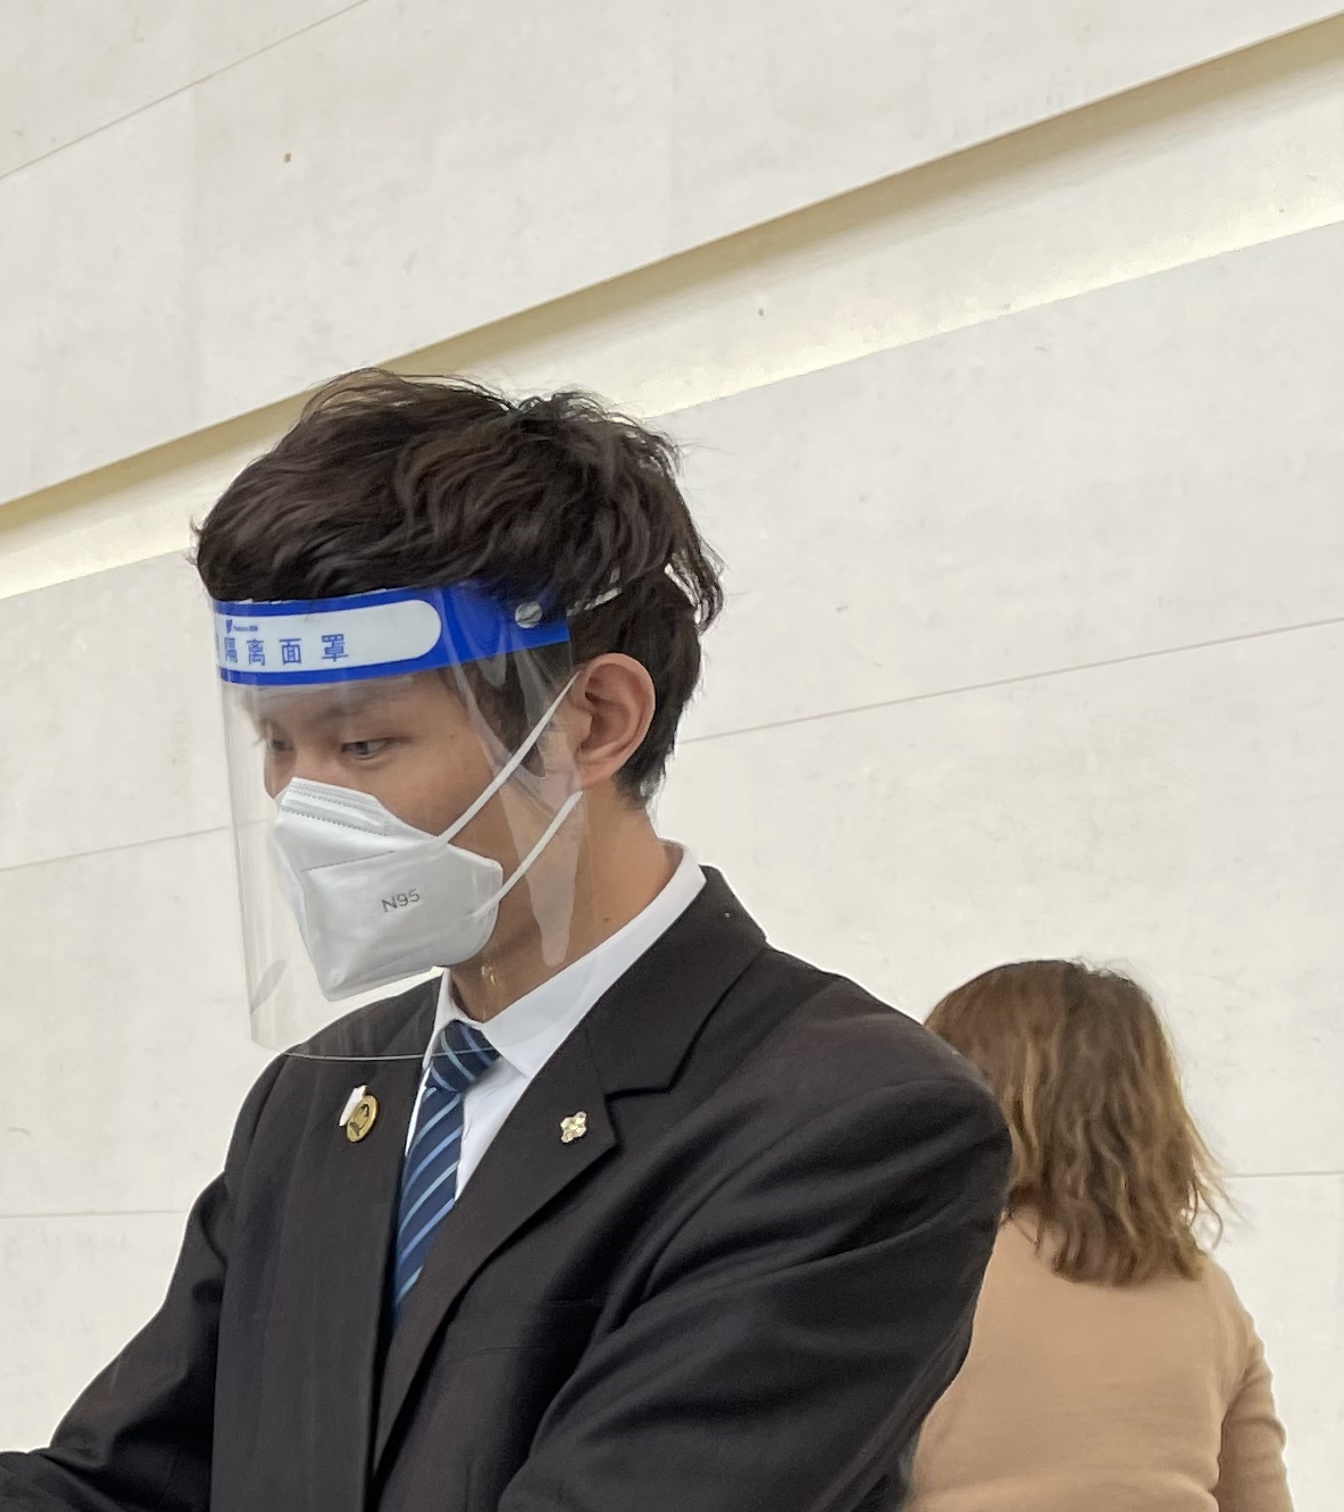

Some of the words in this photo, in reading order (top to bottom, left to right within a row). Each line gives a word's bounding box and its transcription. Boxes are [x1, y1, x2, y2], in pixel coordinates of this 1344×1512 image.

[224, 633, 349, 666] 隔离面罩
[381, 888, 421, 912] N95
